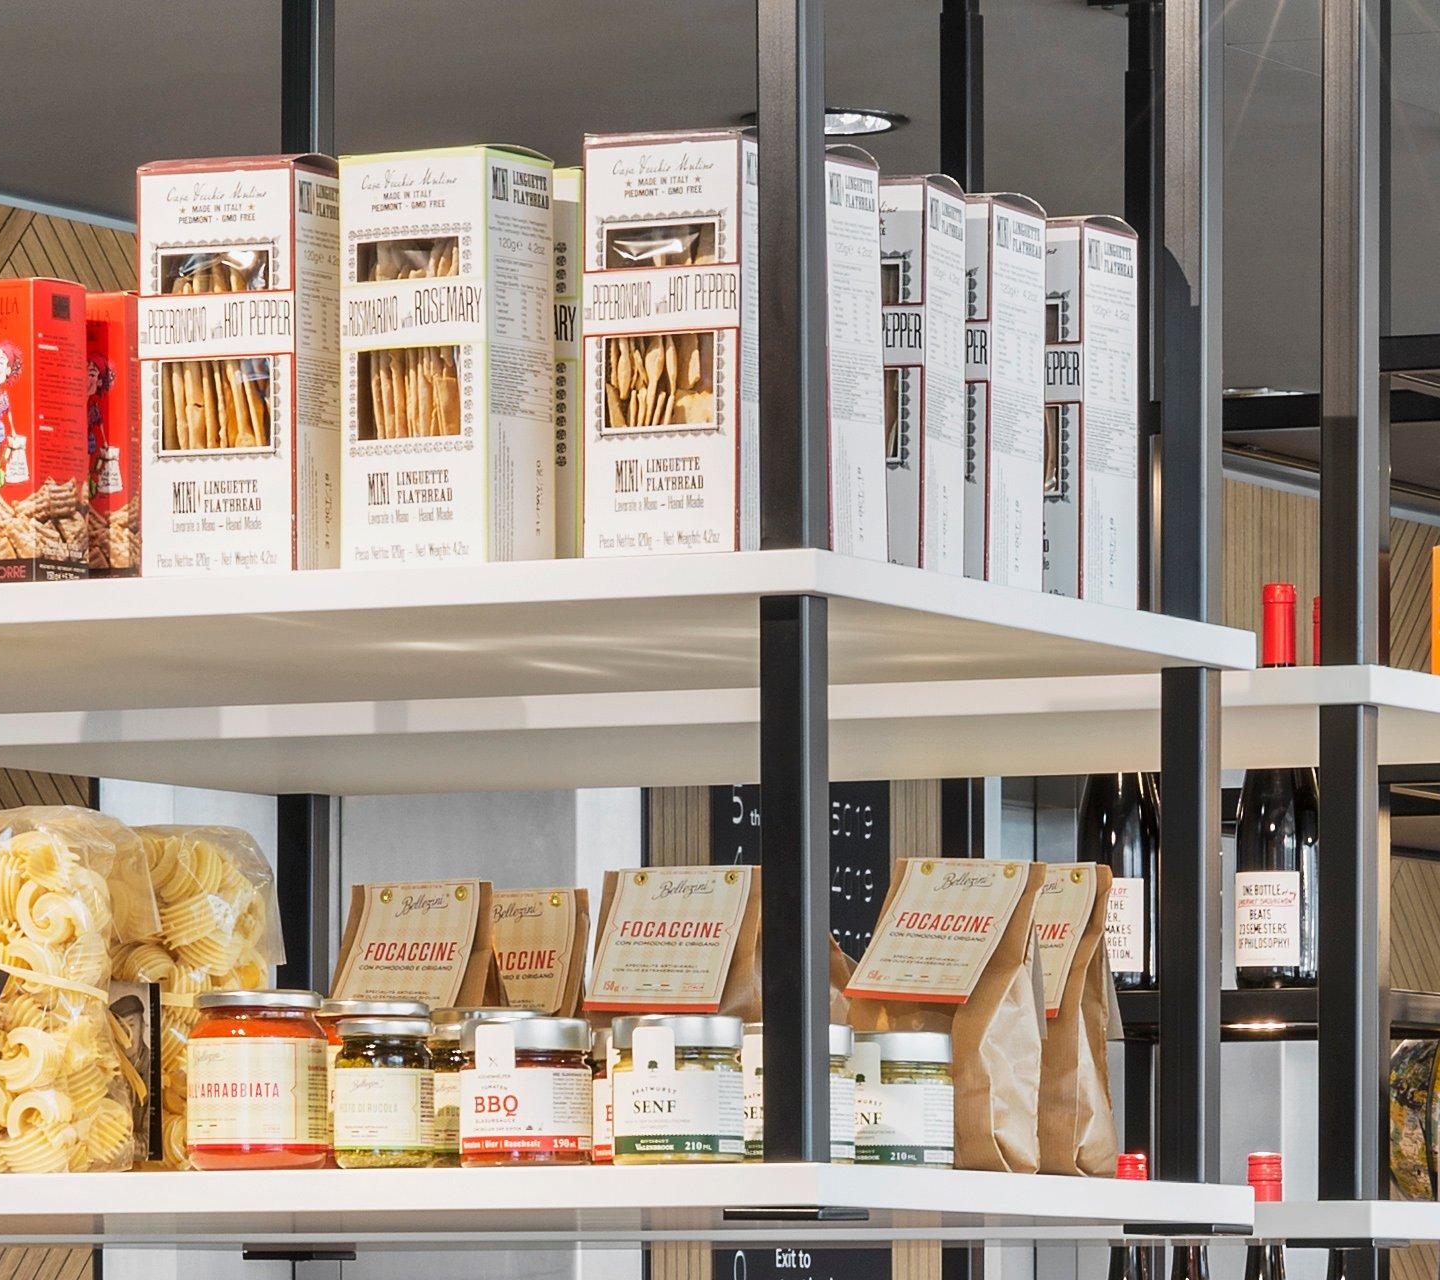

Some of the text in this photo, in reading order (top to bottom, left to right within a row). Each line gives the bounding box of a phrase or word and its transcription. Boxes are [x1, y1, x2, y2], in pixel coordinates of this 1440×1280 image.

[624, 189, 658, 197] PIEDMONT
[668, 187, 683, 195] GMO
[669, 274, 736, 313] HOT PEPPER
[415, 286, 483, 326] ROSEMARY
[224, 300, 291, 338] HOT PEPPER
[397, 469, 449, 486] LINGUETTE
[615, 456, 700, 493] MINI LINGUETTE
[647, 475, 704, 492] FLATBREAD
[173, 479, 258, 514] MINI LINGUETTE
[397, 488, 453, 504] FLATBREAD
[204, 498, 261, 513] FLATBREAD
[1255, 885, 1280, 895] BOTTLE
[896, 912, 995, 933] FOCACCINE
[1250, 909, 1271, 919] BEATS
[620, 921, 724, 939] FOCACCINE
[1247, 924, 1287, 934] SEMESTERS
[364, 942, 457, 961] FOCACCINE
[1245, 938, 1289, 949] PHILOSOPHY!
[474, 1095, 518, 1117] BBQ
[633, 1100, 677, 1114] SENF
[776, 1248, 796, 1268] Exit
[800, 1251, 811, 1268] to
